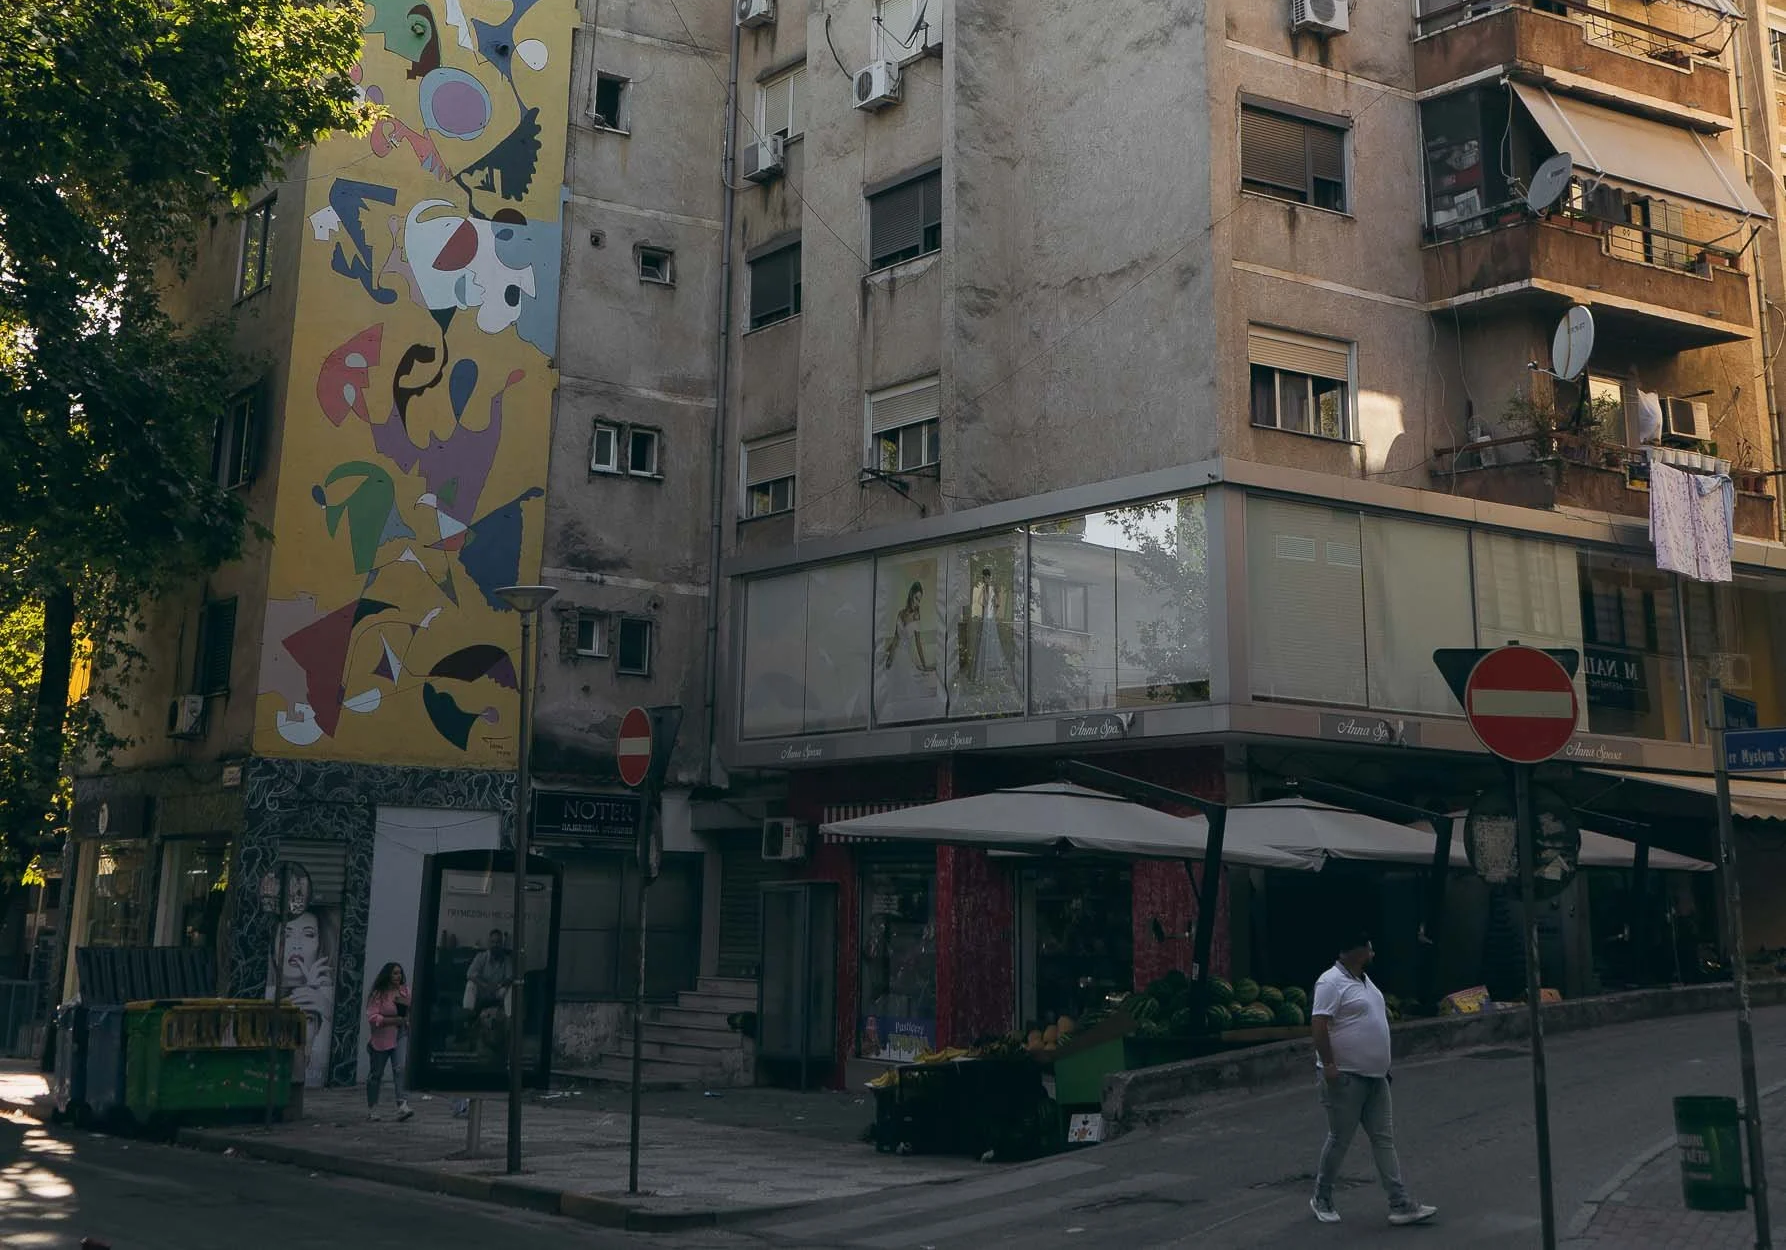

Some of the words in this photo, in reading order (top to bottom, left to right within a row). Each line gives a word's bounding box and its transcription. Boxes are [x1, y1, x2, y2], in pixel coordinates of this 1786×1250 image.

[1070, 720, 1098, 737] Anna
[1337, 718, 1370, 736] Anna
[923, 733, 948, 749] Anna
[1566, 741, 1594, 758] Anna
[1779, 747, 1786, 763] S
[563, 800, 633, 822] NOTER
